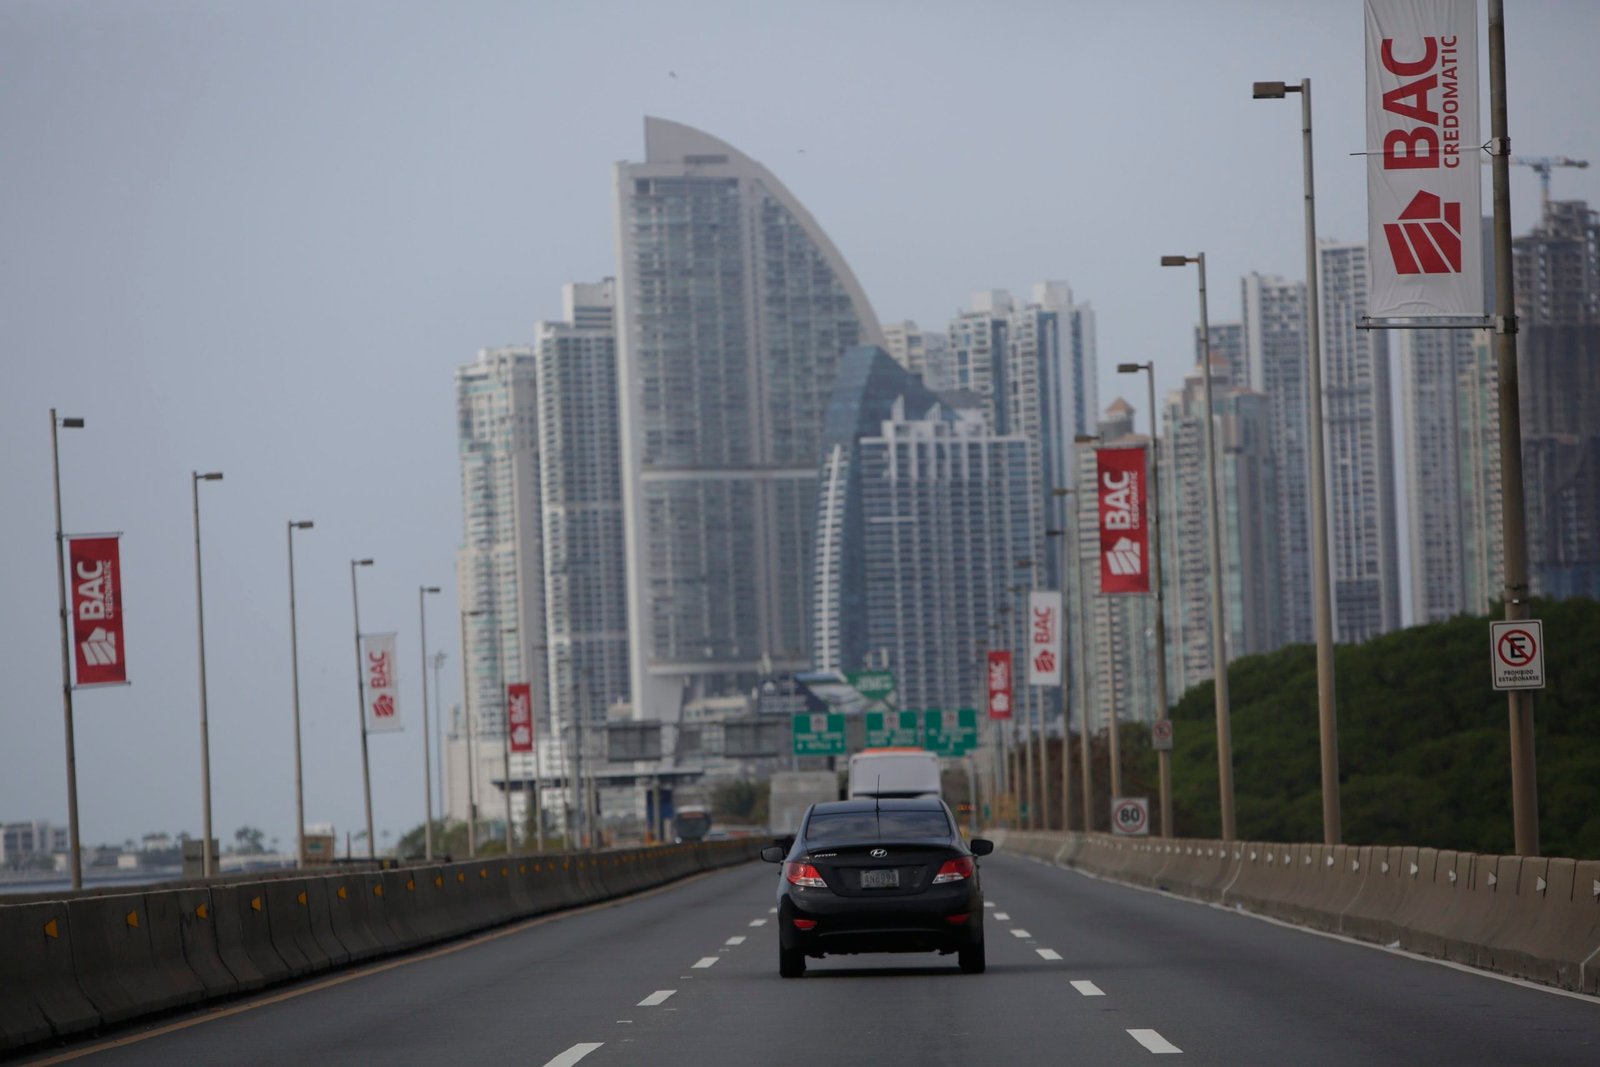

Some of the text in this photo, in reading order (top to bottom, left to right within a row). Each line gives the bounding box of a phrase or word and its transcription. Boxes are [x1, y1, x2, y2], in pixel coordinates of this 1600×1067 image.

[1381, 36, 1439, 169] BAC
[1441, 35, 1460, 168] CREDOMATIC
[1103, 470, 1131, 530] BAC
[77, 560, 105, 620] BAC
[1034, 606, 1051, 644] BAC
[369, 651, 386, 688] BAC
[1121, 808, 1140, 823] 80
